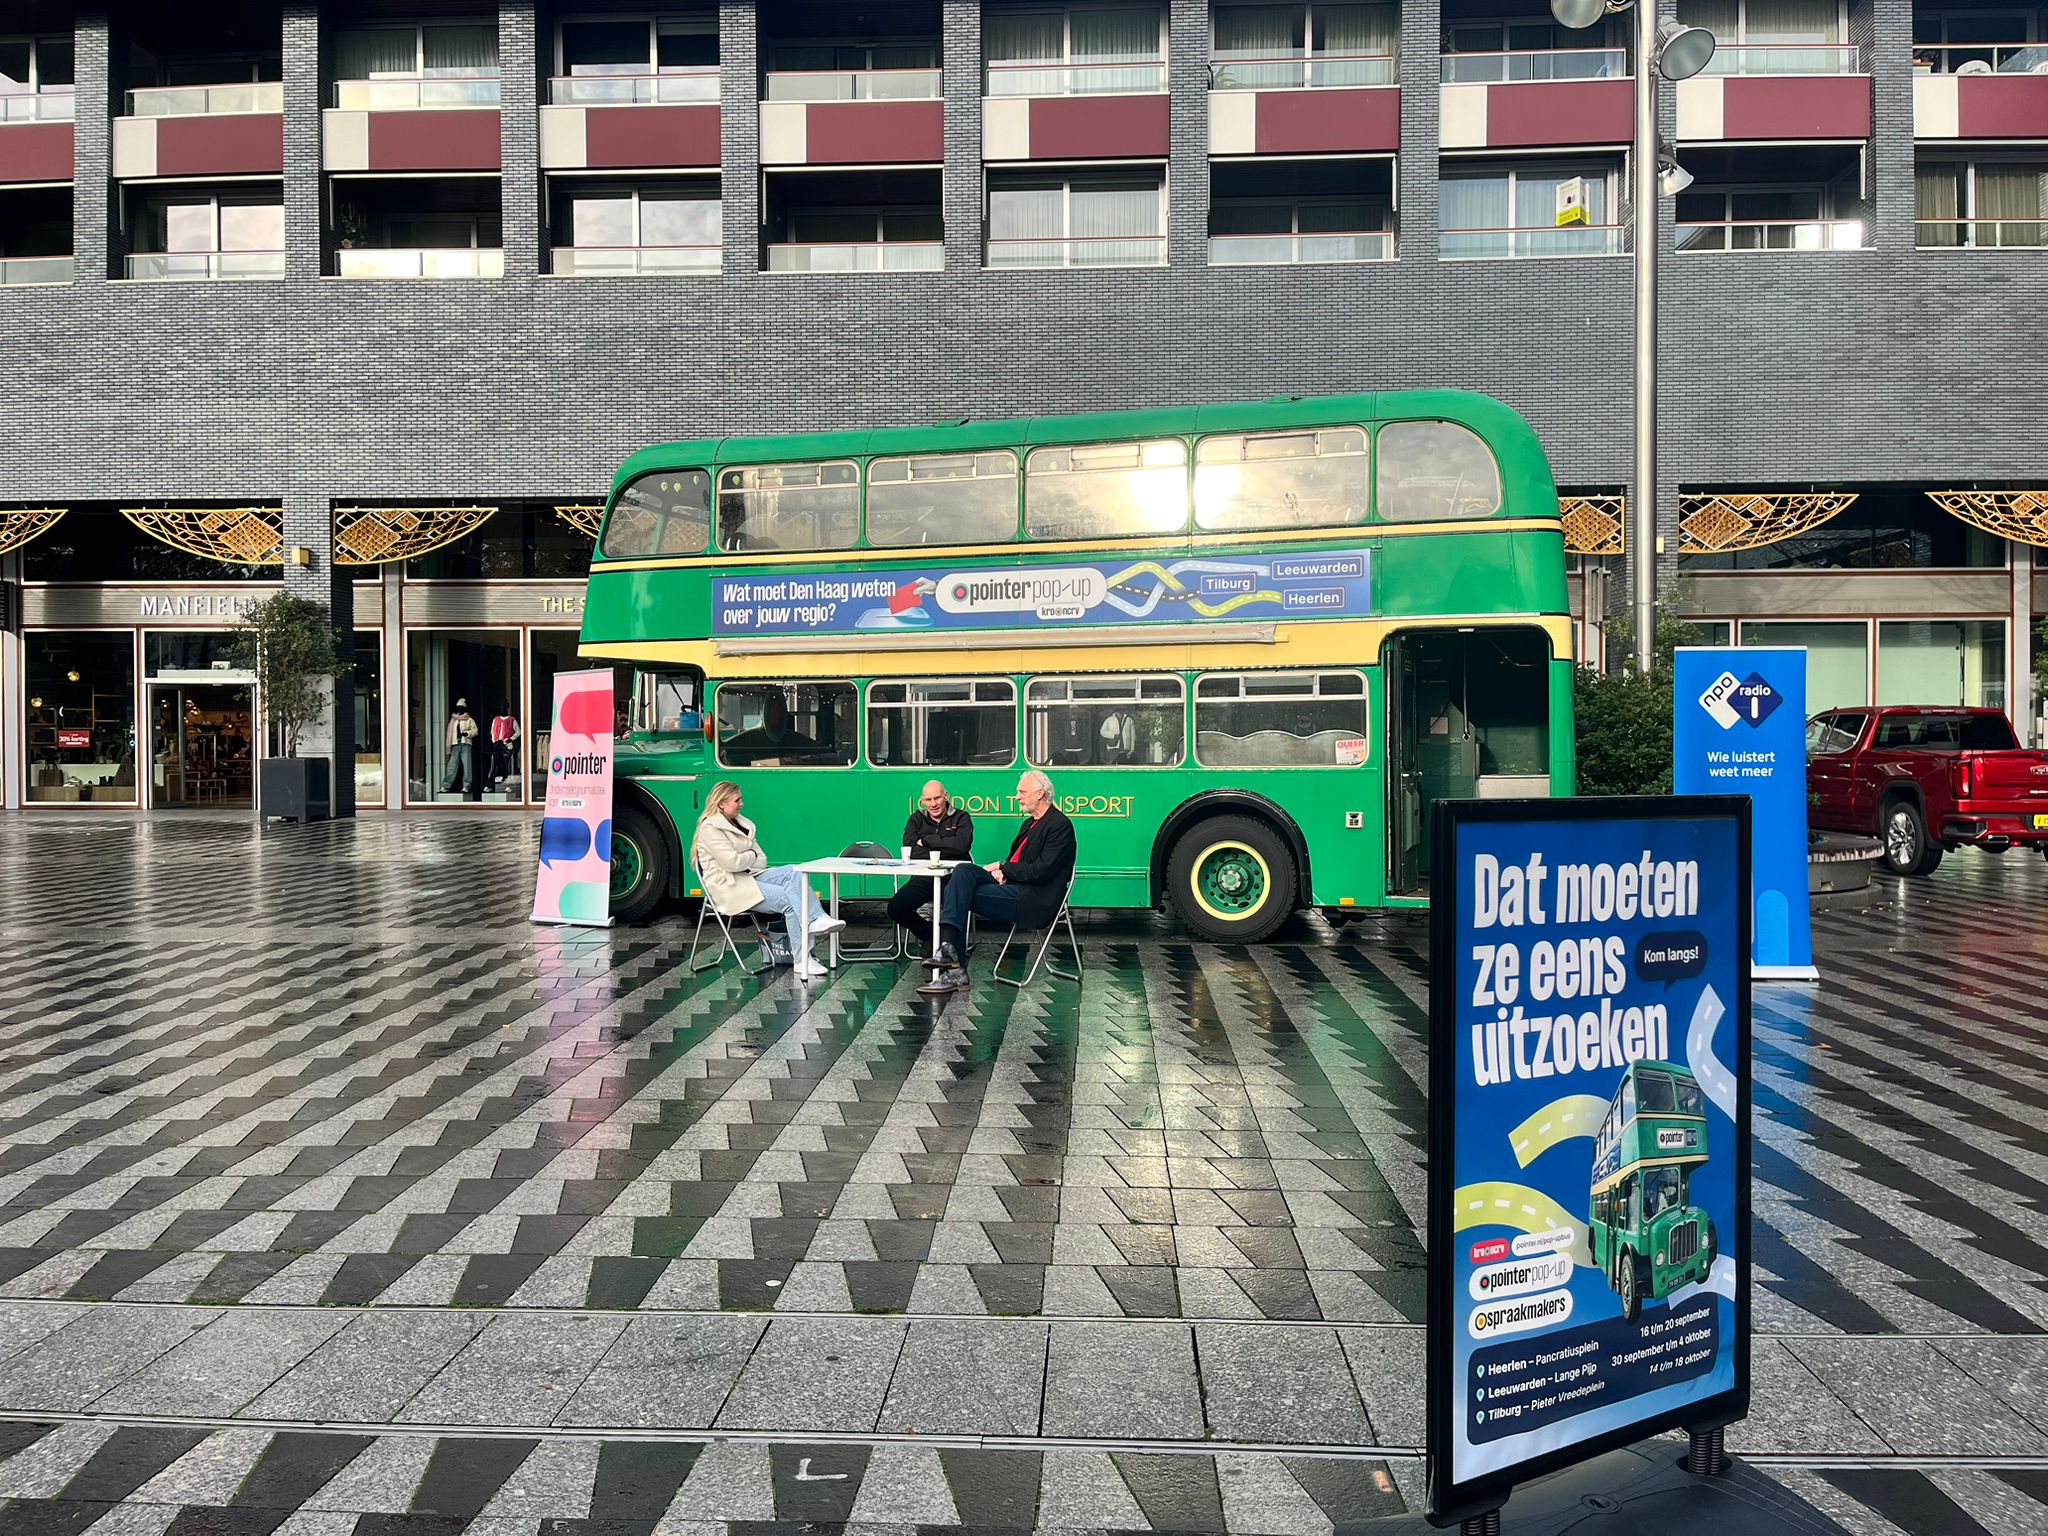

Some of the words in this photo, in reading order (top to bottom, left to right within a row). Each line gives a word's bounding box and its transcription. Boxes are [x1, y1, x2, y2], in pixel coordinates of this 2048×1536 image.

[1277, 562, 1357, 575] Leeuwarden
[724, 584, 751, 602] Wat
[753, 582, 786, 600] moet
[790, 581, 814, 599] Den
[816, 580, 848, 602] Haag
[852, 580, 895, 597] weten
[970, 580, 1030, 605] pointer
[1207, 579, 1250, 590] Tilburg
[541, 598, 575, 611] THE
[1289, 593, 1339, 604] Heerlen
[724, 608, 753, 624] over
[755, 606, 789, 628] jouw
[795, 603, 836, 625] regio?
[1704, 676, 1732, 707] npo
[1739, 685, 1770, 696] radio
[1338, 740, 1364, 748] QUEER
[1707, 752, 1729, 762] Wie
[1732, 751, 1775, 762] luistert
[564, 752, 606, 780] pointer
[1709, 766, 1739, 777] weet
[1742, 768, 1773, 777] meer
[1474, 853, 1547, 928] Dat
[1556, 850, 1698, 924] moeten
[1644, 950, 1665, 963] Kom
[1668, 946, 1698, 963] langs!
[1473, 943, 1519, 1007] ze
[1530, 936, 1626, 1001] eens
[1472, 998, 1668, 1086] uitzoeken
[1517, 1234, 1570, 1250] pointer.nl/pop-upbus
[1491, 1267, 1531, 1292] pointer
[1487, 1298, 1565, 1330] spraakmakers
[1640, 1326, 1649, 1337] 16
[1651, 1323, 1663, 1335] t/m
[1665, 1319, 1674, 1330] 20
[1675, 1308, 1710, 1326] september
[1488, 1360, 1526, 1375] Heerlen
[1536, 1340, 1599, 1365] Pancratiusplein
[1612, 1355, 1622, 1366] 30
[1624, 1344, 1664, 1363] september
[1666, 1340, 1677, 1351] t/m
[1679, 1336, 1683, 1345] 4
[1685, 1329, 1711, 1344] oktober
[1650, 1364, 1658, 1374] 14
[1660, 1361, 1672, 1371] t/m
[1675, 1357, 1683, 1366] 18
[1685, 1349, 1711, 1364] oktober
[1488, 1378, 1546, 1398] Leeuwarden
[1555, 1369, 1580, 1382] Lange
[1582, 1363, 1597, 1375] Pijp
[1488, 1405, 1521, 1420] Tilburg
[1532, 1396, 1556, 1410] Pieter
[1558, 1381, 1604, 1401] Vreedeplein
